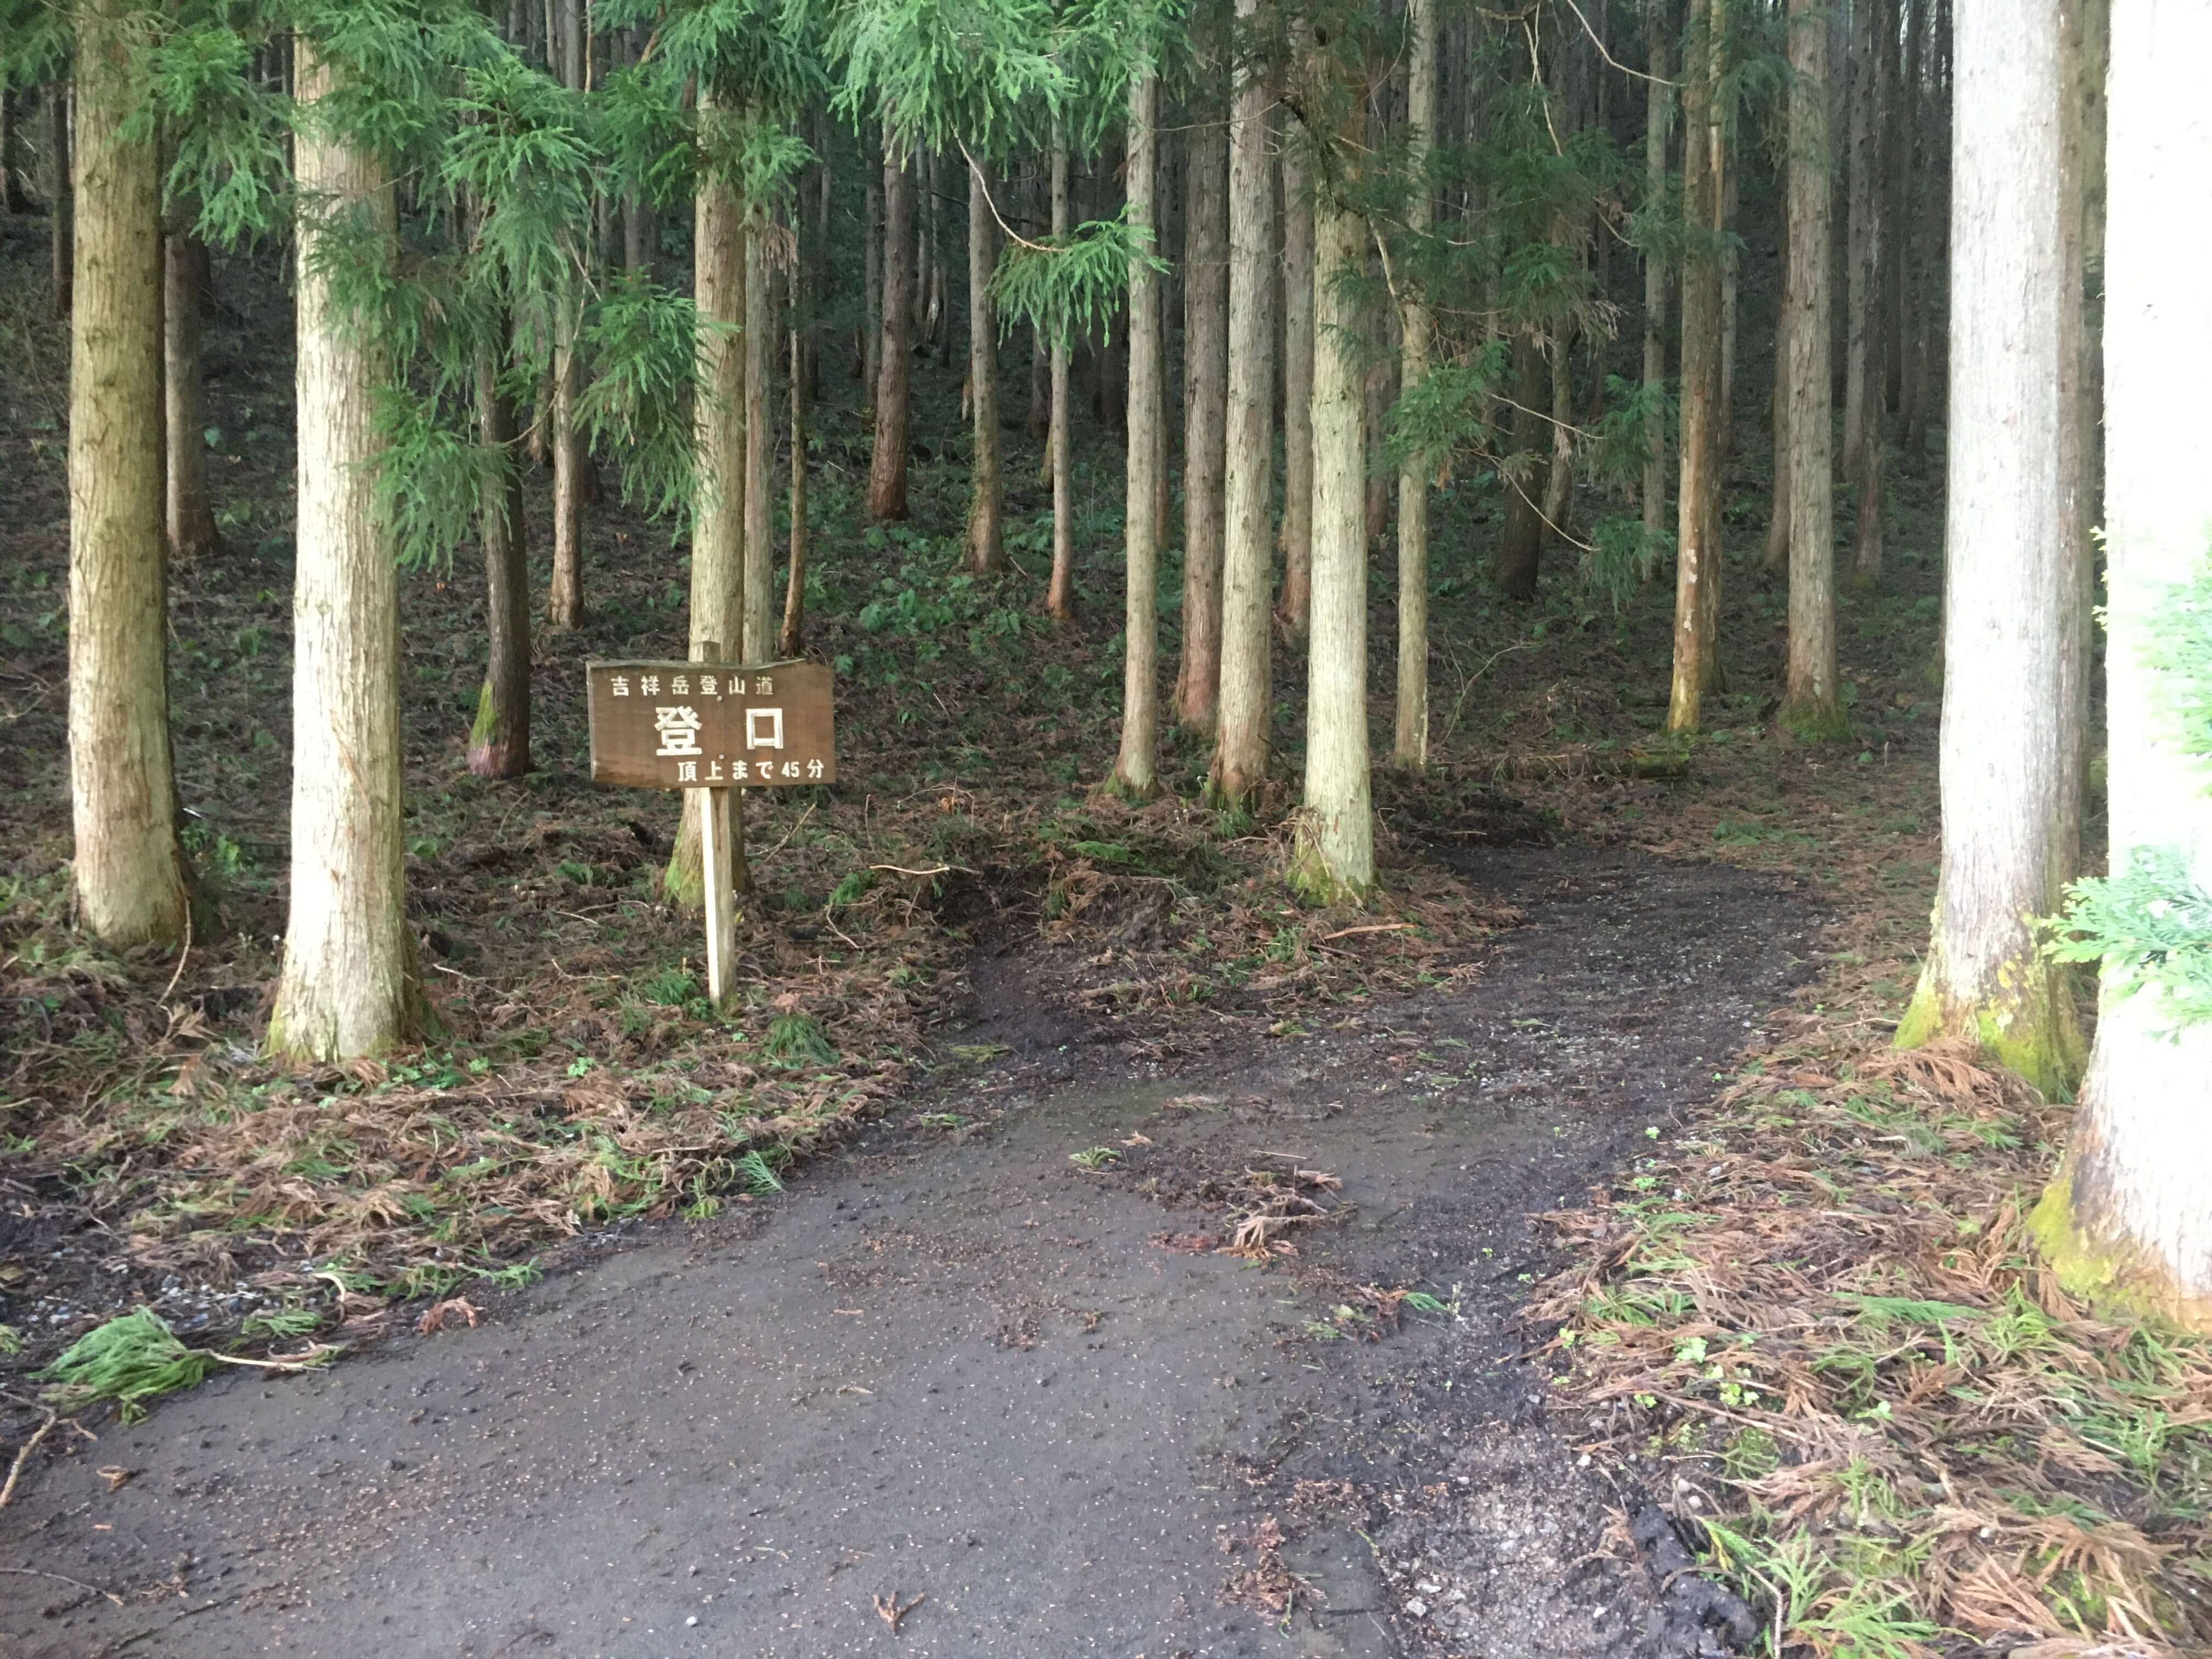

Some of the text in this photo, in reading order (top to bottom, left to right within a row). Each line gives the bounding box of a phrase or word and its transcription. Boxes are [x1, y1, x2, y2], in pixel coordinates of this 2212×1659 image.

[611, 675, 773, 696] 吉祥岳登山道
[654, 706, 783, 756] 登口
[678, 759, 825, 782] 頂上まで45分
